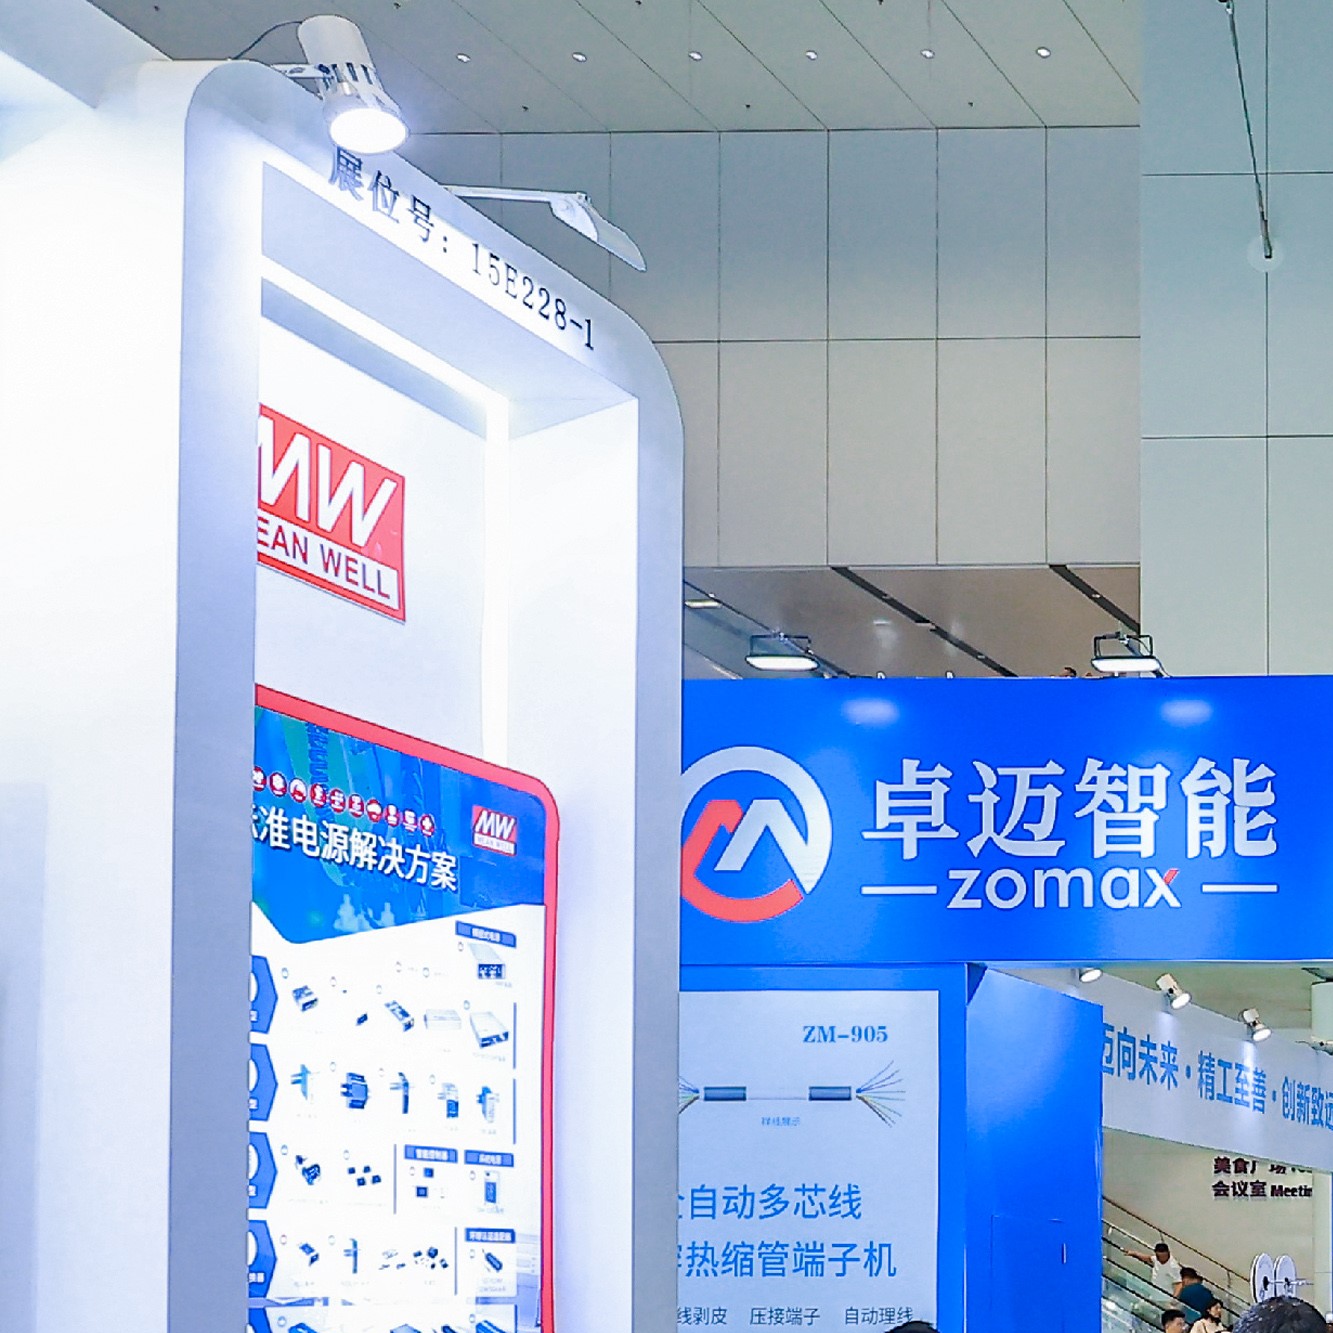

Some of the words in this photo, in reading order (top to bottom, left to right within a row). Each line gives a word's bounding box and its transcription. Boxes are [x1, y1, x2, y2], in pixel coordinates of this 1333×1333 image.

[257, 516, 308, 566] EAN
[320, 543, 391, 600] WELL
[474, 809, 516, 841] MW
[861, 757, 1279, 862] 卓迈智能
[947, 866, 1182, 911] zomax
[802, 1025, 888, 1044] ZM-905
[1211, 1179, 1267, 1197] 会议室
[676, 1240, 898, 1278] 热缩管端子机
[749, 1306, 821, 1326] 压接端子
[844, 1306, 914, 1326] 自动理线
